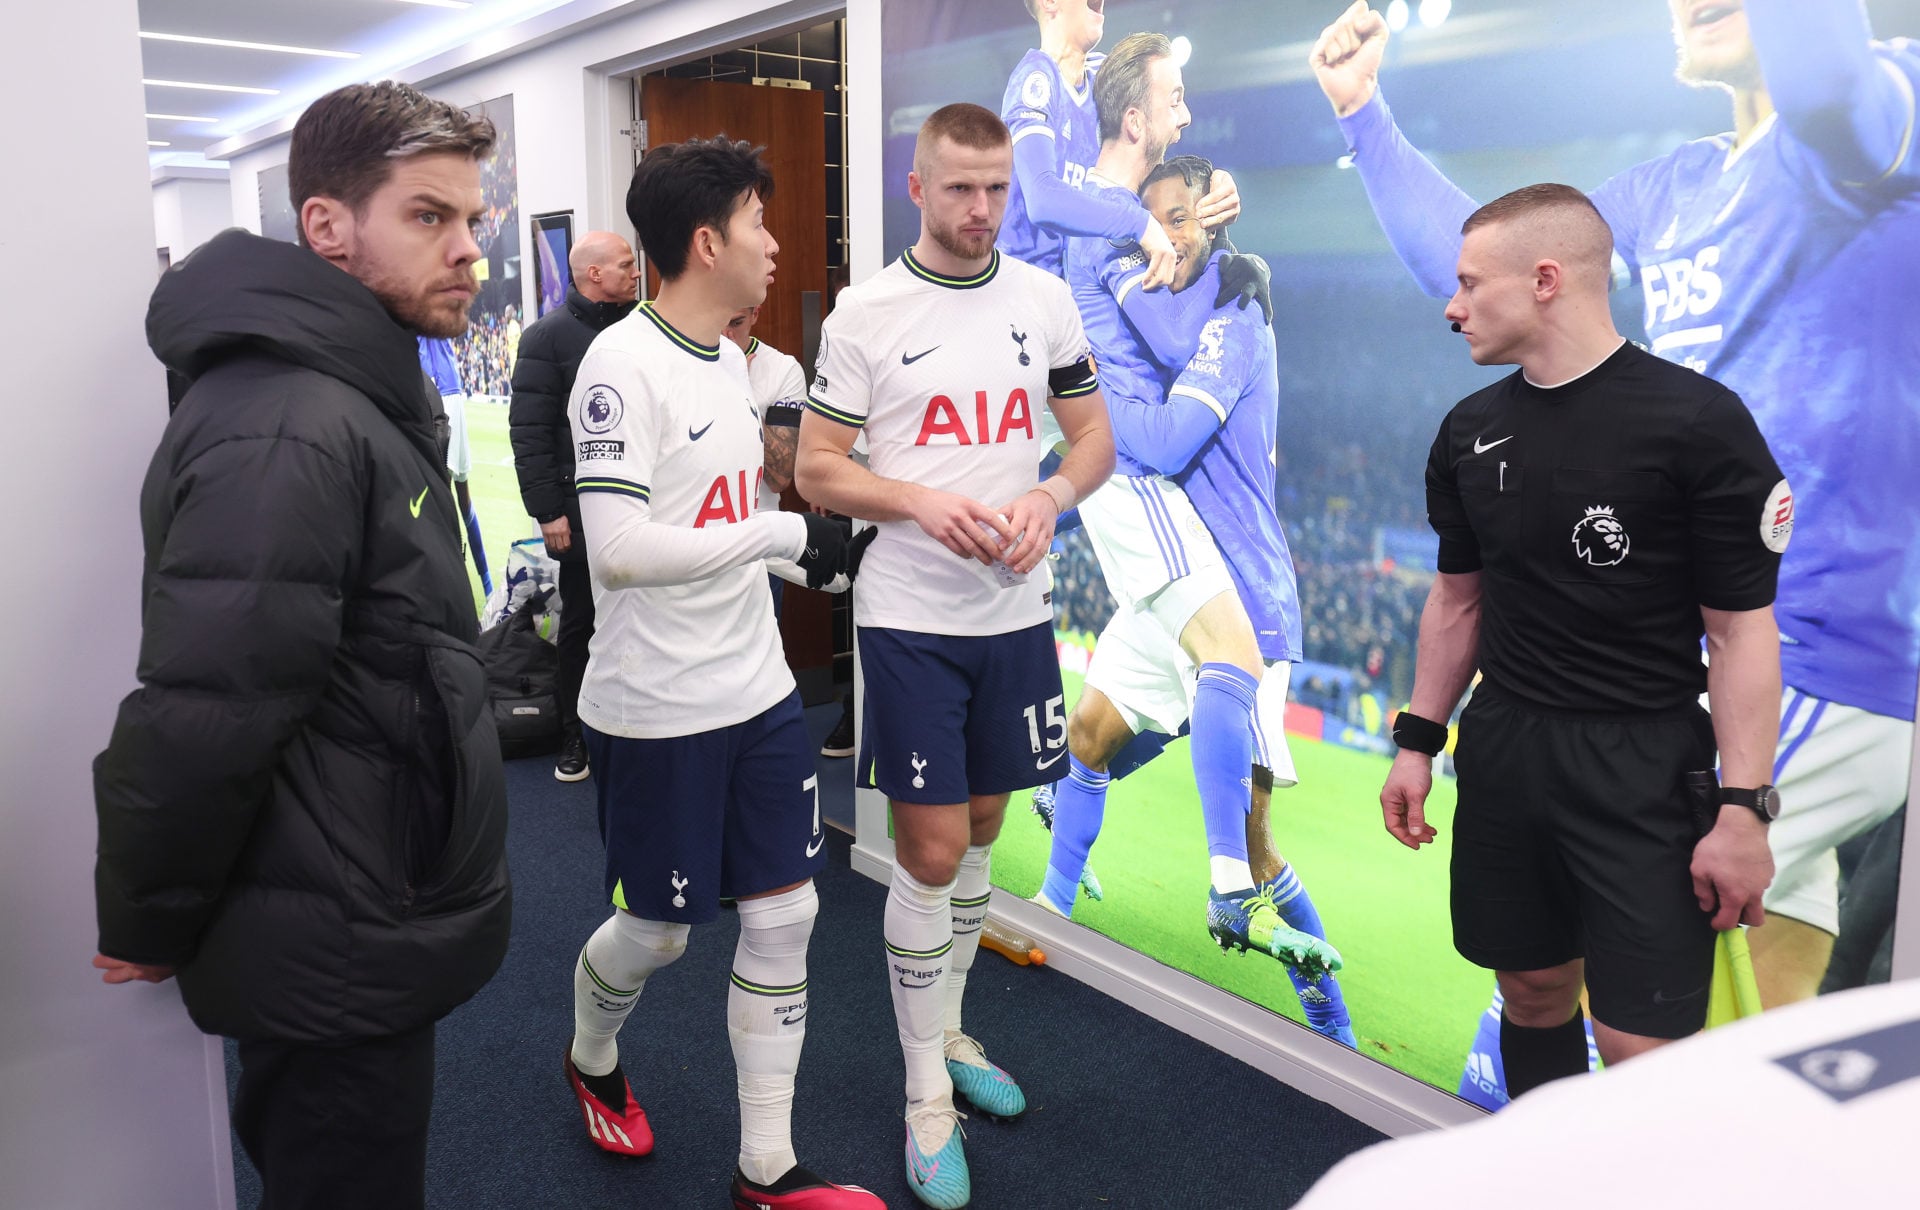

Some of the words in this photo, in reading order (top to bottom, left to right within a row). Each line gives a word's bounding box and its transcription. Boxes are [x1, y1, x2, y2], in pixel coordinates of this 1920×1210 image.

[1640, 245, 1722, 331] FBS
[1184, 359, 1223, 378] AIGON
[914, 387, 1034, 447] AIA
[578, 443, 590, 453] No
[590, 441, 620, 452] room
[589, 451, 624, 461] racism
[1023, 693, 1068, 754] 15
[802, 771, 820, 837] 7
[952, 913, 986, 926] PUR
[893, 964, 943, 980] SPURS
[773, 1000, 808, 1015] SPU
